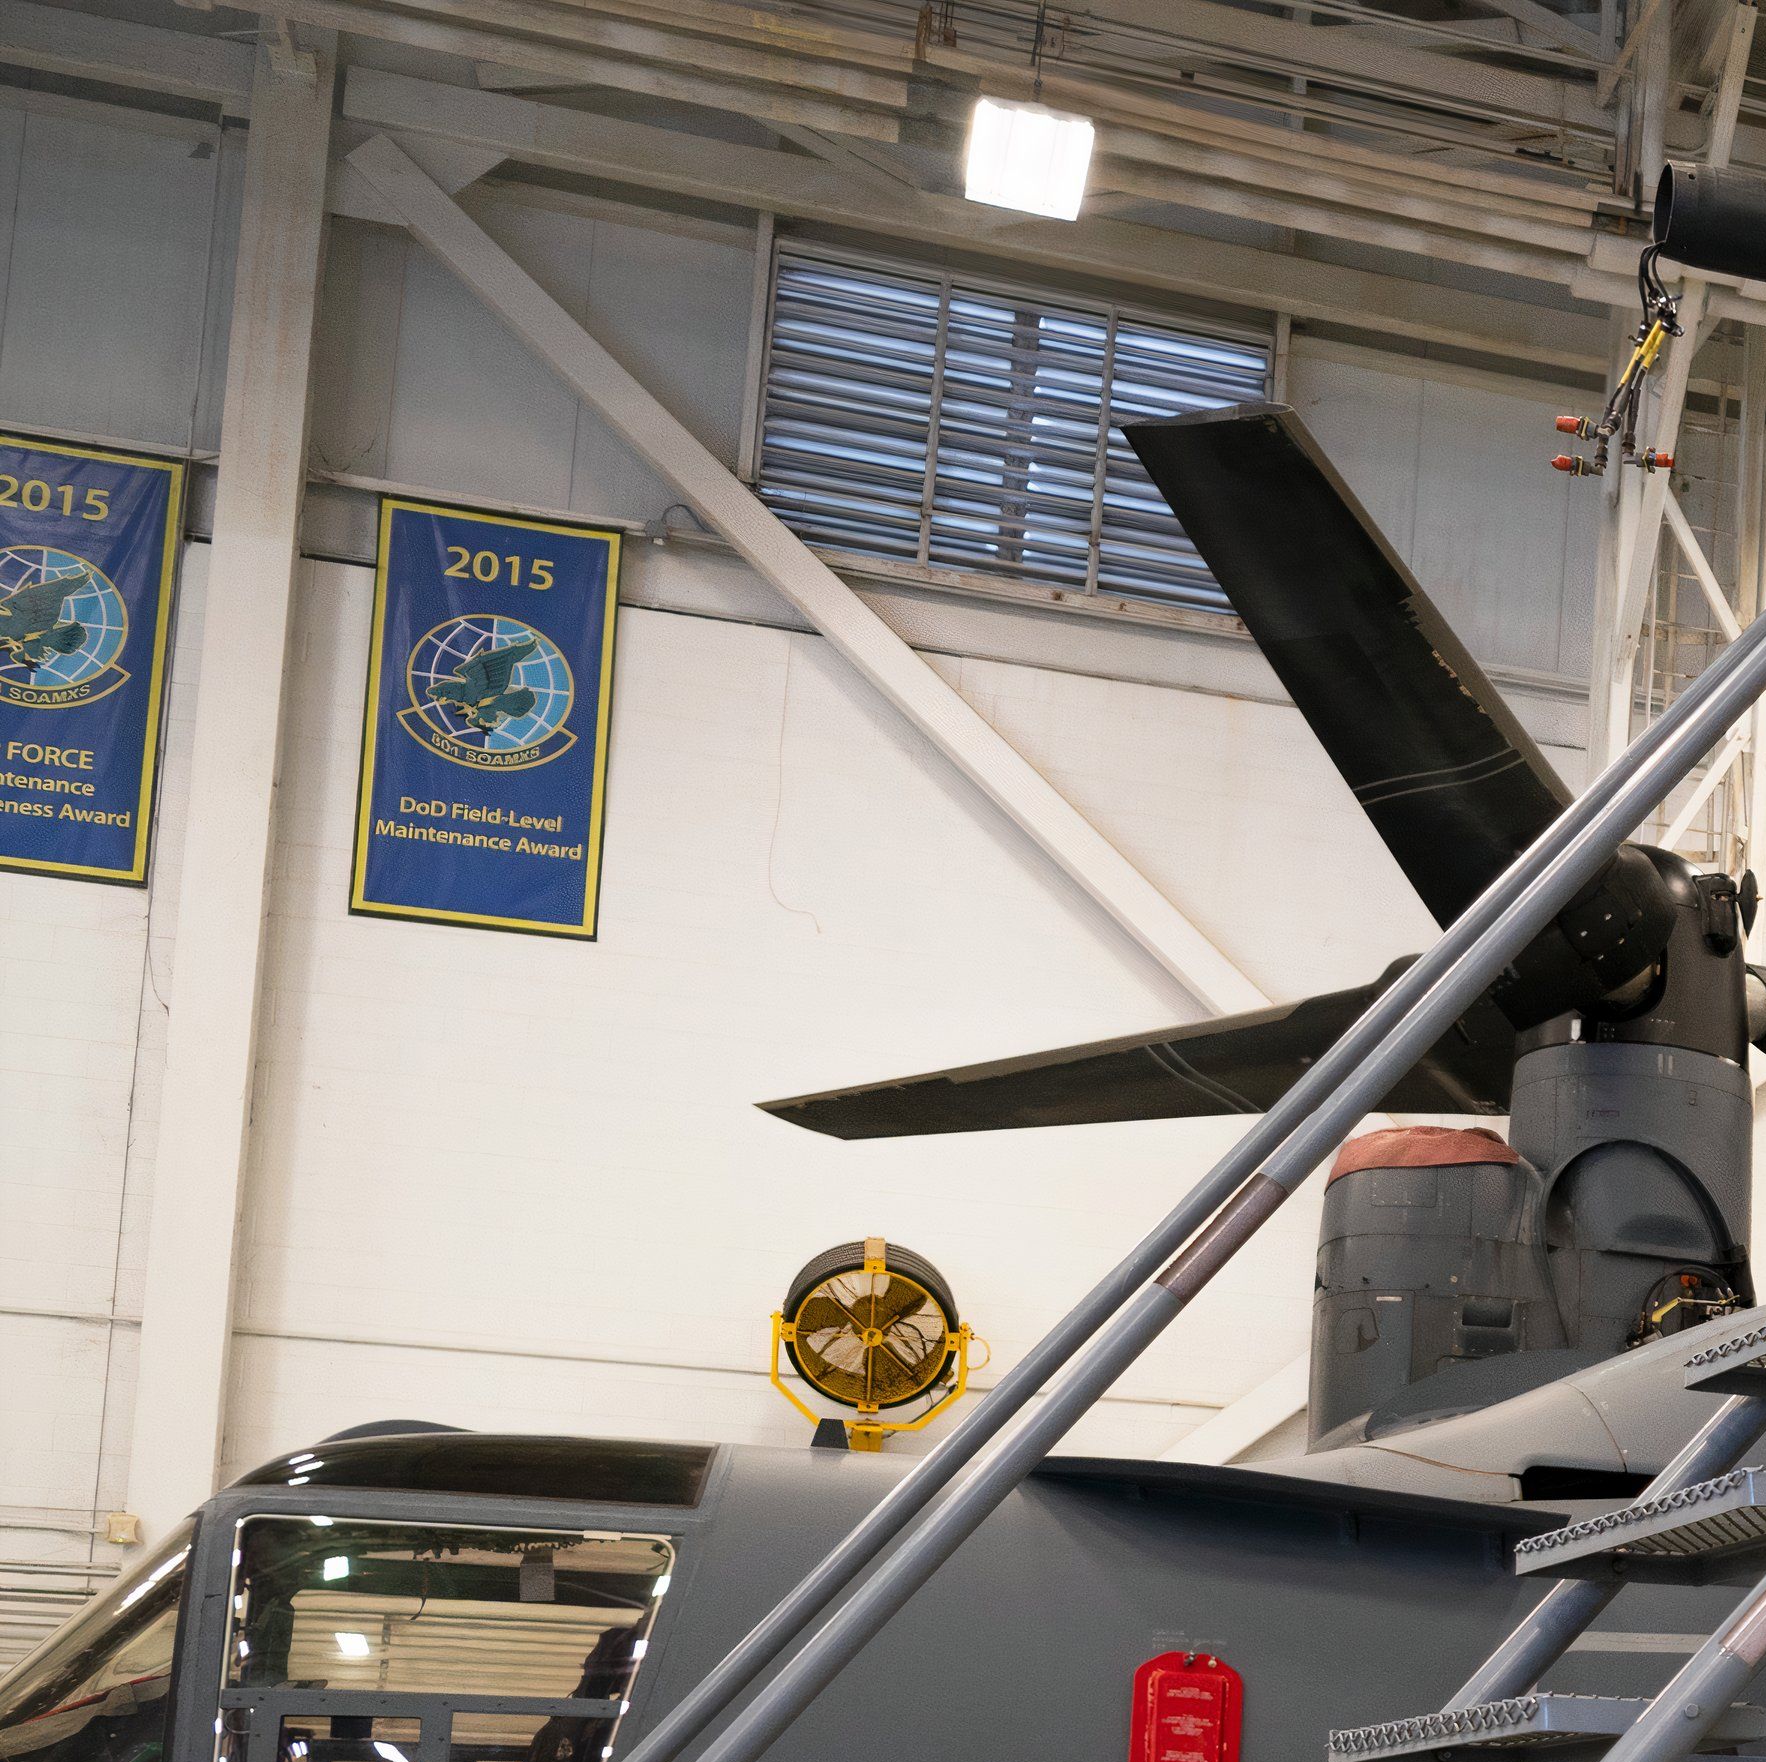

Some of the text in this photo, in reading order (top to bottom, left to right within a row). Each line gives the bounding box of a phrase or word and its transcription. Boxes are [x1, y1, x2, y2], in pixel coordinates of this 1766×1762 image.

[0, 473, 110, 521] 2015
[444, 545, 555, 591] 2015
[6, 741, 95, 770] FORCE
[0, 800, 132, 828] ness Award
[399, 796, 564, 833] DoD Field-Level
[374, 819, 583, 861] Maintenance Award
